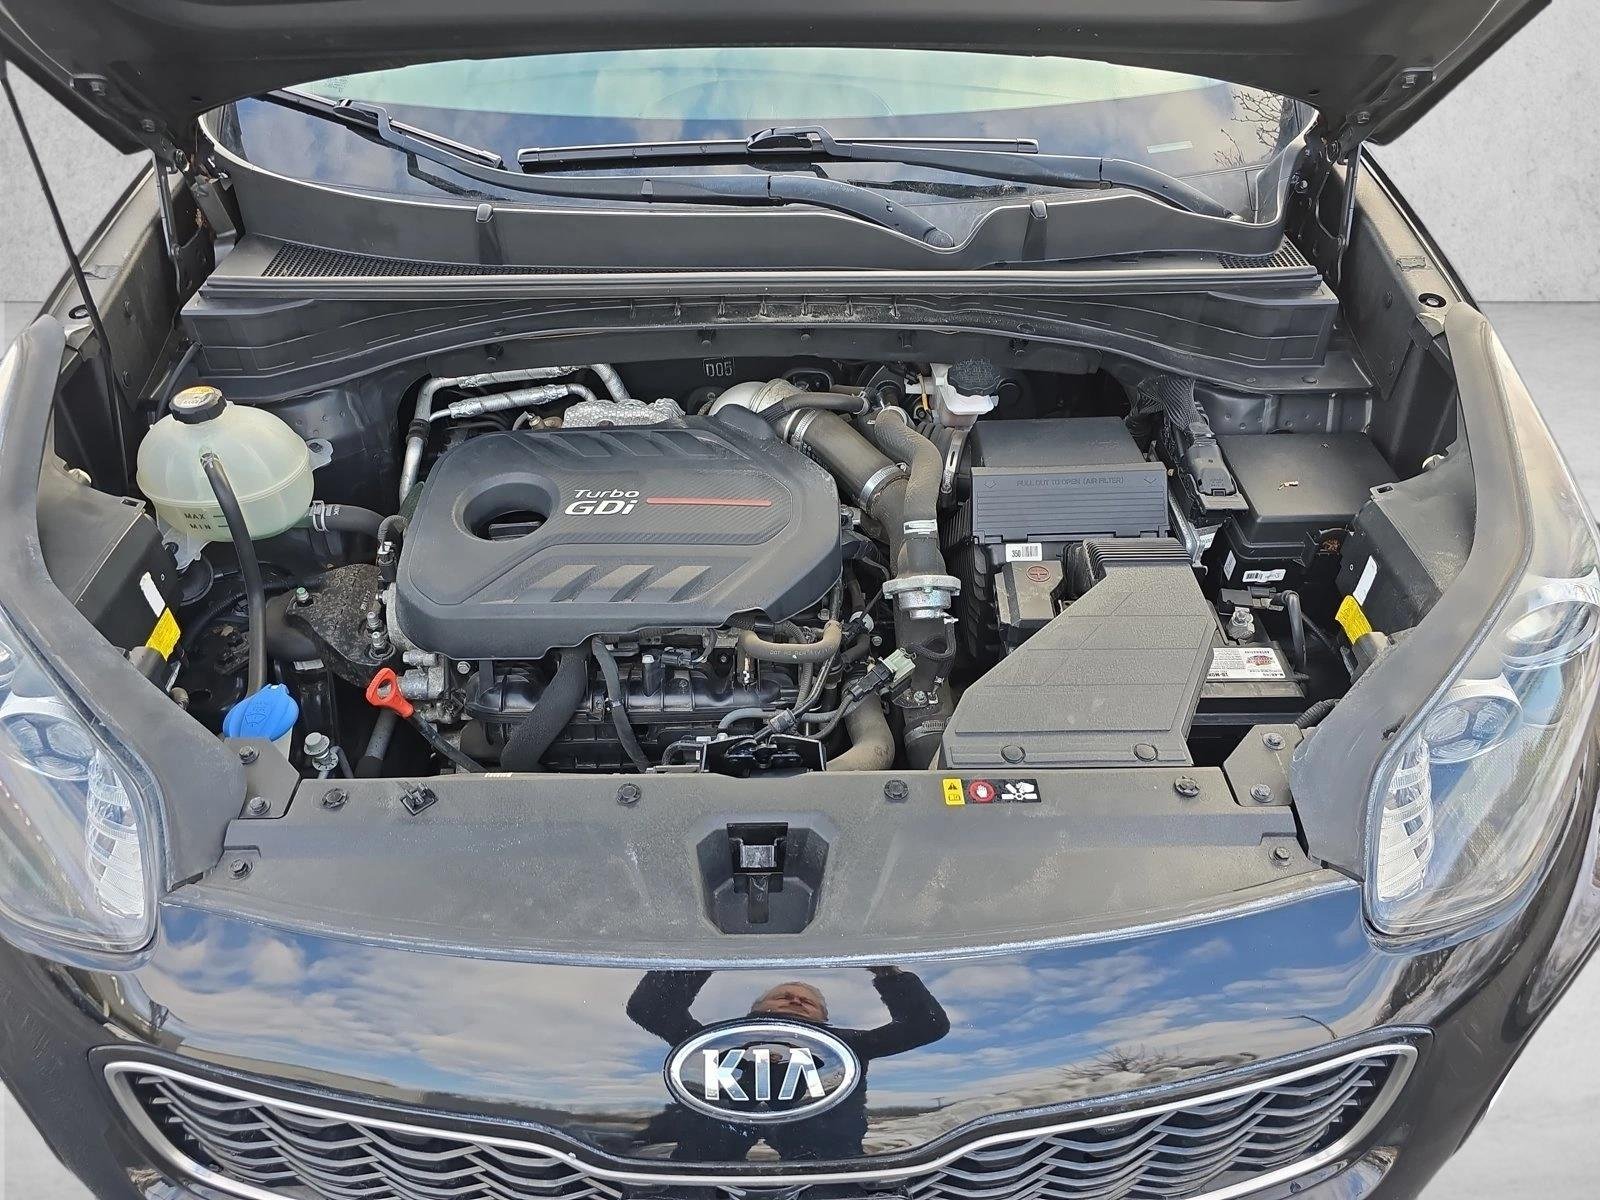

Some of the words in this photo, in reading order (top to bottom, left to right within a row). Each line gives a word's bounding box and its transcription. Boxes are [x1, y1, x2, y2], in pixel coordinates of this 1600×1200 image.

[1016, 479, 1035, 487] PULL
[1035, 479, 1049, 487] OUT
[1061, 478, 1081, 486] OPEN
[1082, 477, 1098, 486] (AIR
[1098, 476, 1125, 485] FILTER)
[574, 489, 640, 499] Turbo
[564, 499, 639, 516] GDi
[184, 512, 206, 520] MAX
[702, 1048, 826, 1101] KIA
